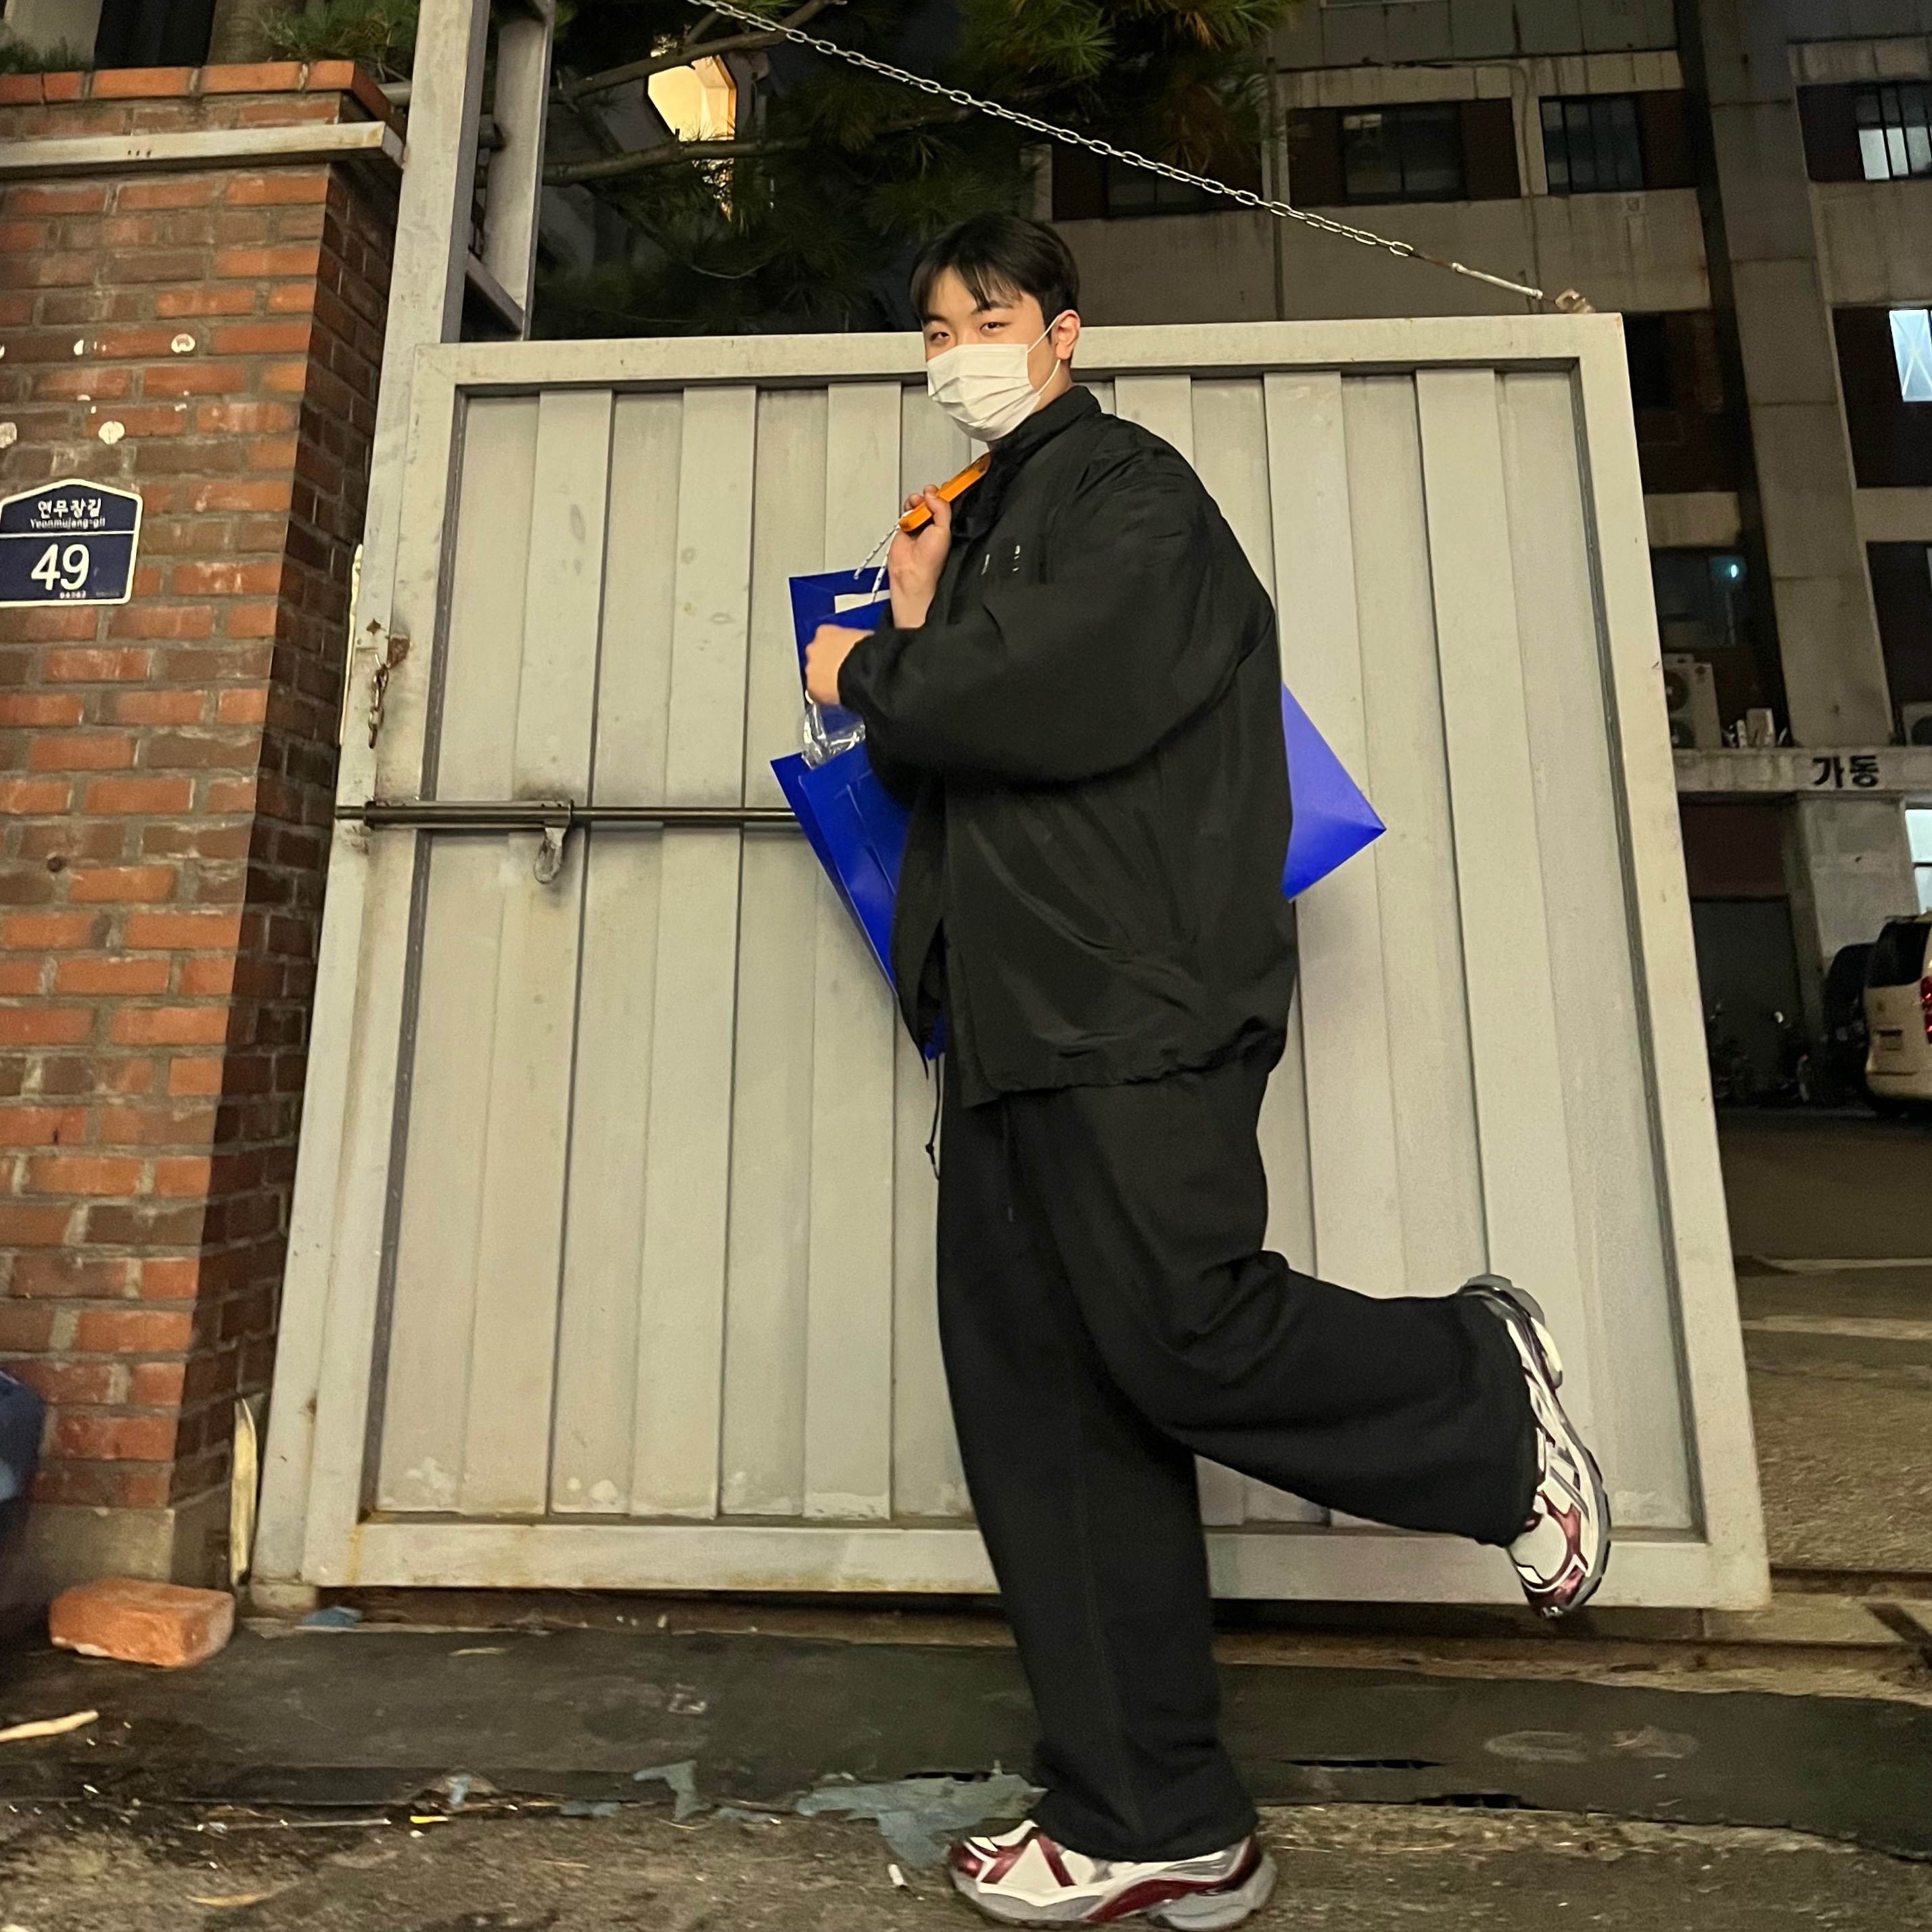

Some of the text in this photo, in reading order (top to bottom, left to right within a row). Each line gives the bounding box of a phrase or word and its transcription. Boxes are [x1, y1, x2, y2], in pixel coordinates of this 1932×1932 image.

[38, 498, 101, 519] 연무장길
[31, 543, 90, 591] 49
[1812, 754, 1879, 788] 가동
